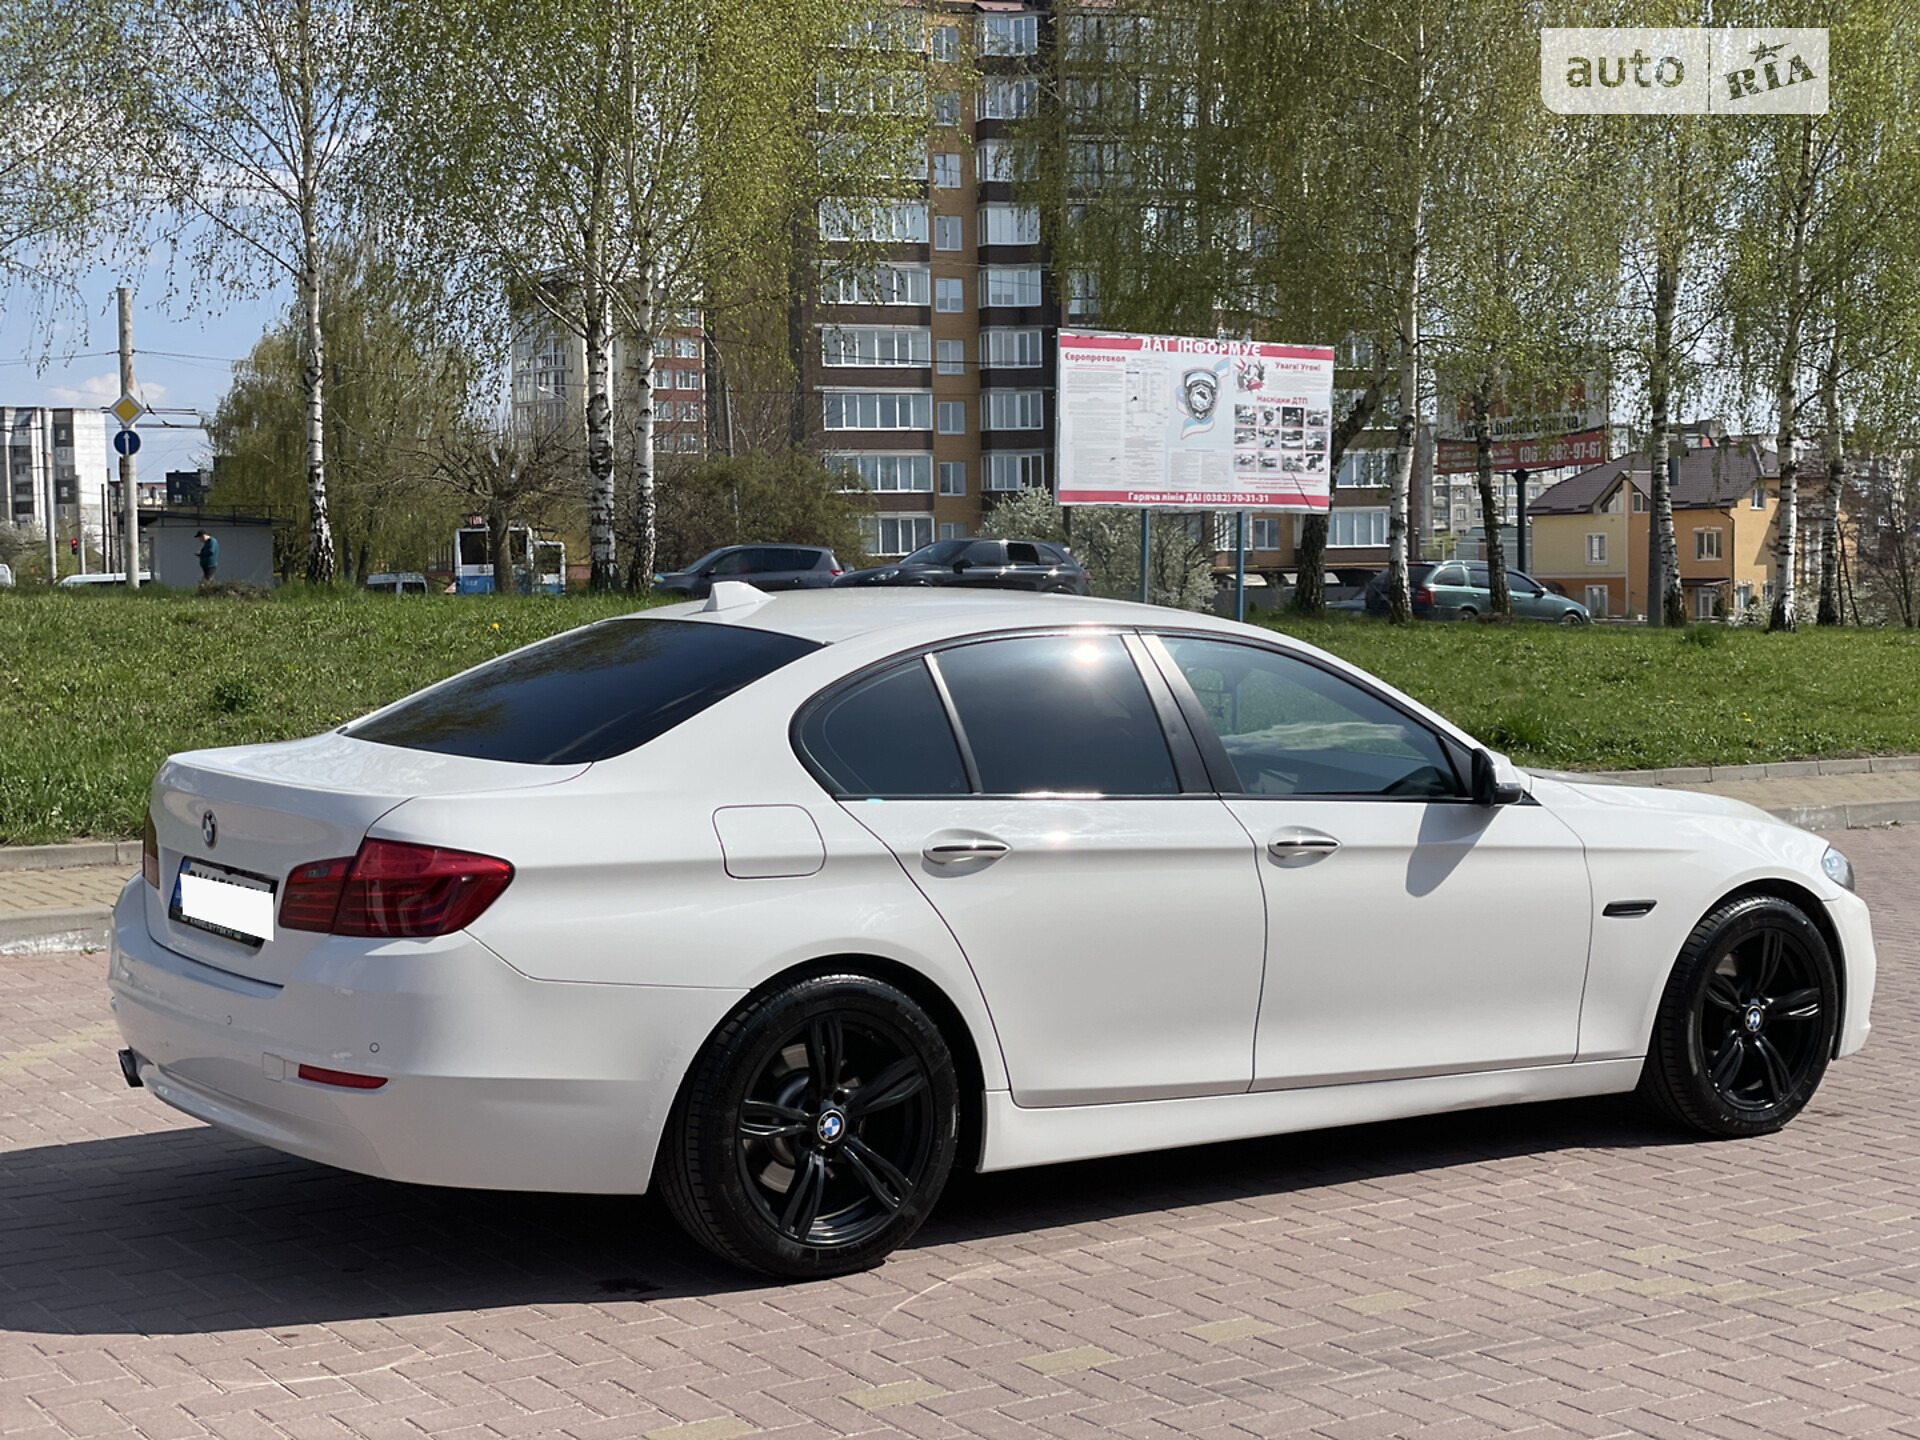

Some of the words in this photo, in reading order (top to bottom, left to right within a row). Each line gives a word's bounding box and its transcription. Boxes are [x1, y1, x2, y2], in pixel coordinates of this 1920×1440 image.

[1140, 338, 1169, 352] ДАІ
[1178, 339, 1261, 357] ІНФОРМУЄ
[1064, 352, 1126, 363] Європротокол
[1292, 397, 1308, 405] ДТП
[1128, 492, 1160, 503] Гаряча
[1162, 492, 1184, 501] лінія
[1185, 493, 1201, 502] ДАІ
[1203, 493, 1231, 503] (0382)
[1232, 494, 1269, 503] 70-31-31
